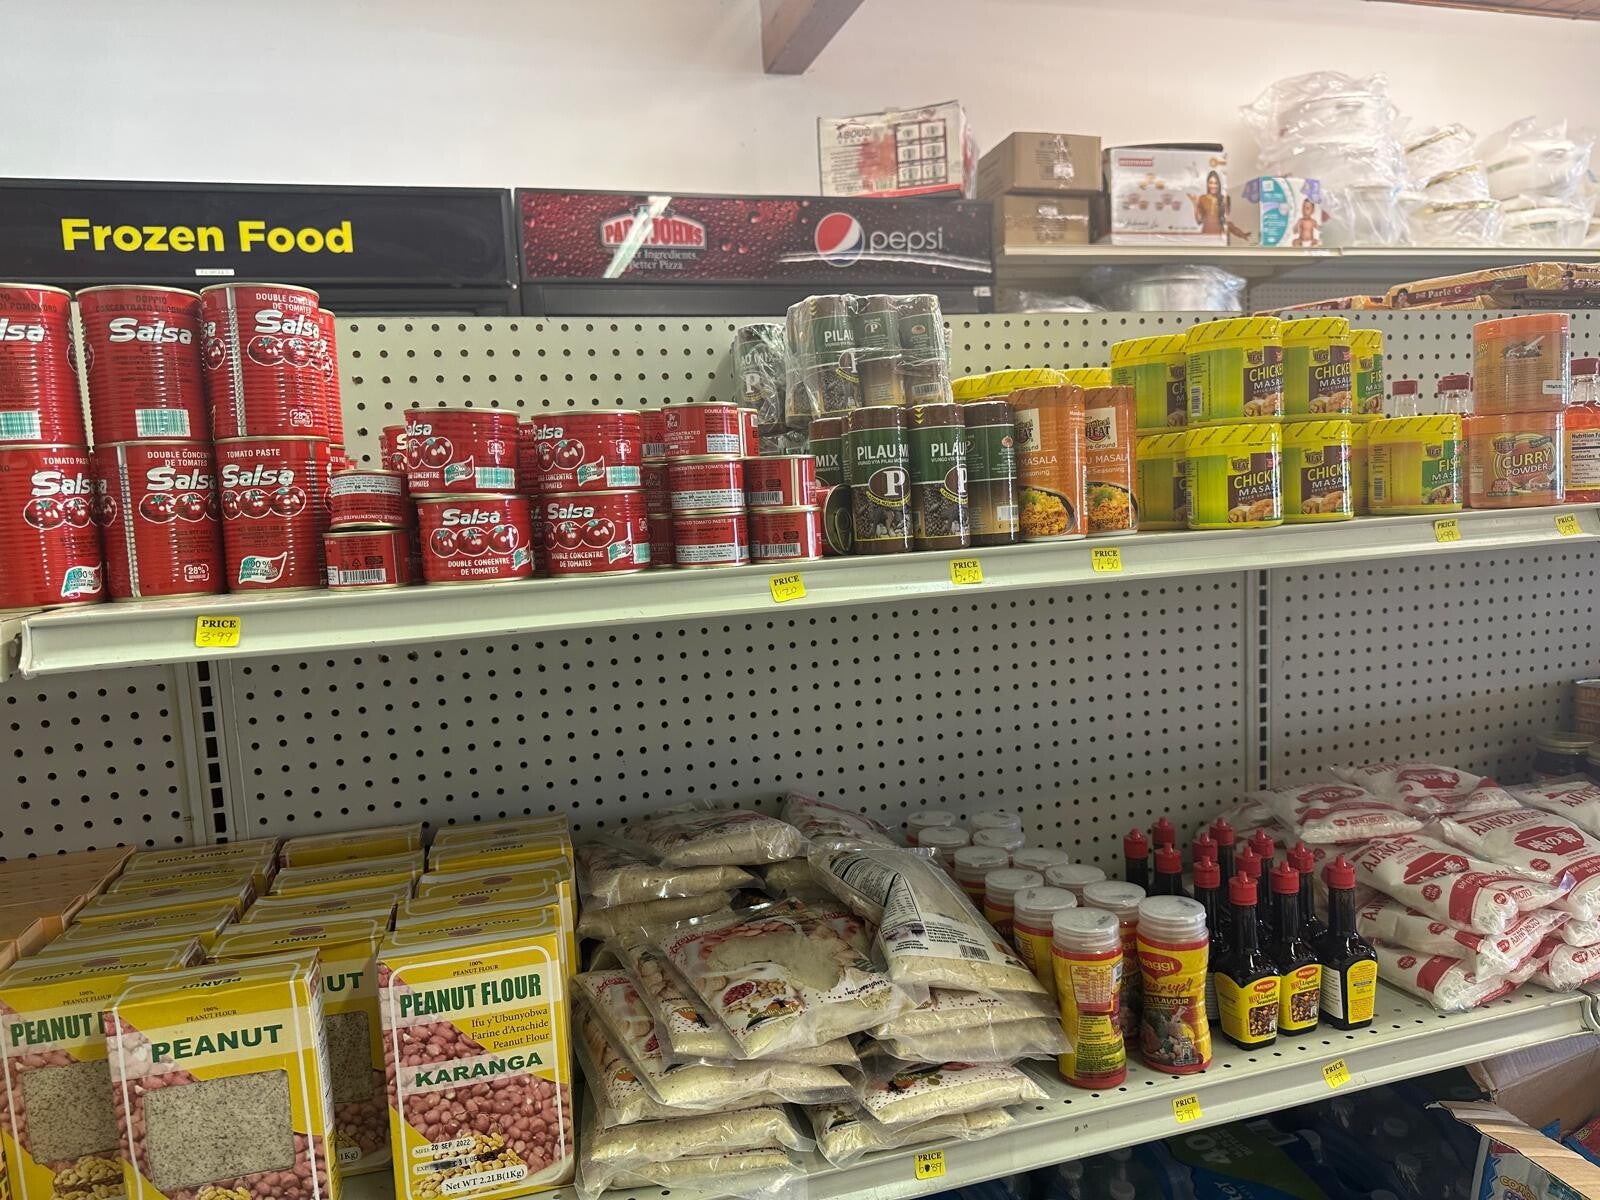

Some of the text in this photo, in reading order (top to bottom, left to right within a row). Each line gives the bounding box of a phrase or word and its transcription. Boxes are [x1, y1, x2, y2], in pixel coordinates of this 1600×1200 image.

[61, 218, 354, 253] Frozen Food
[869, 226, 944, 255] pepsi
[256, 293, 287, 303] DOUBLE
[0, 318, 45, 342] lsa
[108, 317, 193, 345] Salsa
[824, 330, 854, 342] PILAU
[1249, 363, 1283, 382] CHICKE
[1315, 362, 1350, 380] CHICKE
[1370, 370, 1382, 383] FIS
[406, 421, 433, 436] alsa
[857, 444, 896, 461] PILAU
[931, 441, 965, 458] PILAU
[1094, 442, 1116, 450] Ground
[147, 451, 180, 459] DOUBLE
[227, 448, 280, 458] TOMATO PASTE
[1502, 447, 1551, 469] CURRY
[43, 457, 75, 465] TOMATO
[178, 459, 208, 467] TOMATES
[816, 454, 838, 468] MIX
[222, 464, 295, 488] Salsa
[1092, 466, 1125, 474] Seasoning
[1307, 464, 1343, 481] CHICK
[1506, 463, 1548, 477] POWDER
[31, 470, 92, 496] Sals
[883, 470, 906, 497] P
[1233, 469, 1272, 489] CHICK
[1312, 477, 1343, 489] MASA
[1238, 485, 1271, 497] MASA
[443, 508, 501, 526] Salsa
[547, 503, 595, 520] Salsa
[1437, 521, 1456, 529] PRICE
[1557, 515, 1574, 525] PRICE
[570, 549, 604, 559] CONCENTRE
[1094, 550, 1118, 558] PRICE
[448, 559, 472, 567] DOUBLE
[568, 559, 592, 567] TOMATES
[953, 560, 977, 569] PRICE
[188, 566, 206, 575] 28%
[472, 566, 499, 575] TOMATES
[773, 575, 799, 586] PRICE
[201, 620, 236, 629] PRICE
[451, 888, 501, 898] PEANUT
[418, 918, 520, 936] PEANUT FLOUR
[273, 934, 327, 945] PEANUT
[452, 964, 499, 977] PEANUT FLOUR
[1142, 959, 1175, 971] aggi
[32, 962, 148, 982] PEANUT FLOUR
[180, 977, 242, 990] PEANUT
[63, 994, 112, 1006] PEANUT FLOUR
[400, 984, 477, 1018] PEANUT
[481, 973, 542, 1006] FLOUR
[1261, 991, 1276, 999] Liquid
[186, 1009, 237, 1023] PEANUT FLOUR
[471, 1018, 485, 1028] Ifu
[10, 1014, 92, 1047] PEANUT
[471, 1019, 549, 1041] Farine d'Arachide
[152, 1024, 283, 1063] PEANUT
[493, 1032, 550, 1049] Peanut Flour
[415, 1052, 543, 1087] KARANGA
[1325, 1060, 1344, 1075] PRICE
[1175, 1097, 1197, 1107] PRICE
[431, 1142, 440, 1150] 20
[456, 1139, 471, 1147] 2022
[917, 1151, 942, 1161] PRICE
[446, 1168, 525, 1191] Net WT 2.2LB(1Kg)
